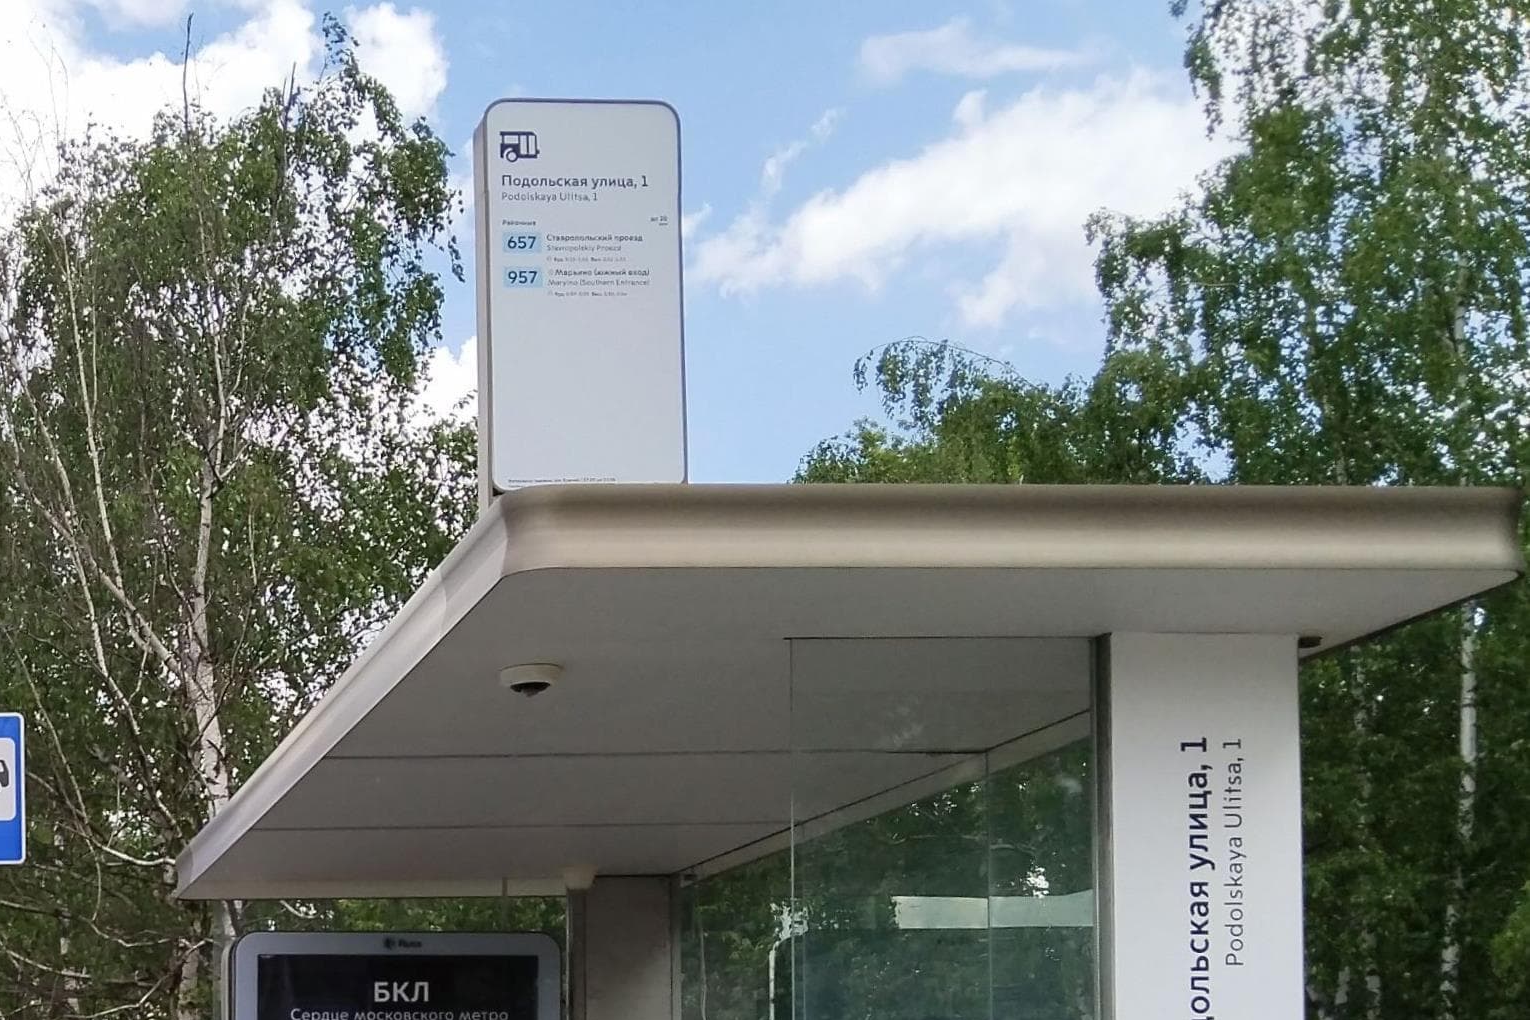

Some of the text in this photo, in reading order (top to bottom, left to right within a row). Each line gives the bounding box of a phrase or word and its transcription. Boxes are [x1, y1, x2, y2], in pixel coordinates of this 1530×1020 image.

[501, 174, 649, 189] Подольская улица, 1
[501, 191, 599, 203] Podolskaya Ulitsa, 1
[506, 235, 537, 250] 657
[546, 233, 612, 242] Ставропольский
[507, 270, 538, 284] 957
[1181, 736, 1208, 752] 1
[1188, 762, 1216, 871] улица,
[1223, 738, 1246, 967] Podolskaya Ulitsa, 1
[373, 981, 430, 1003] БКЛ
